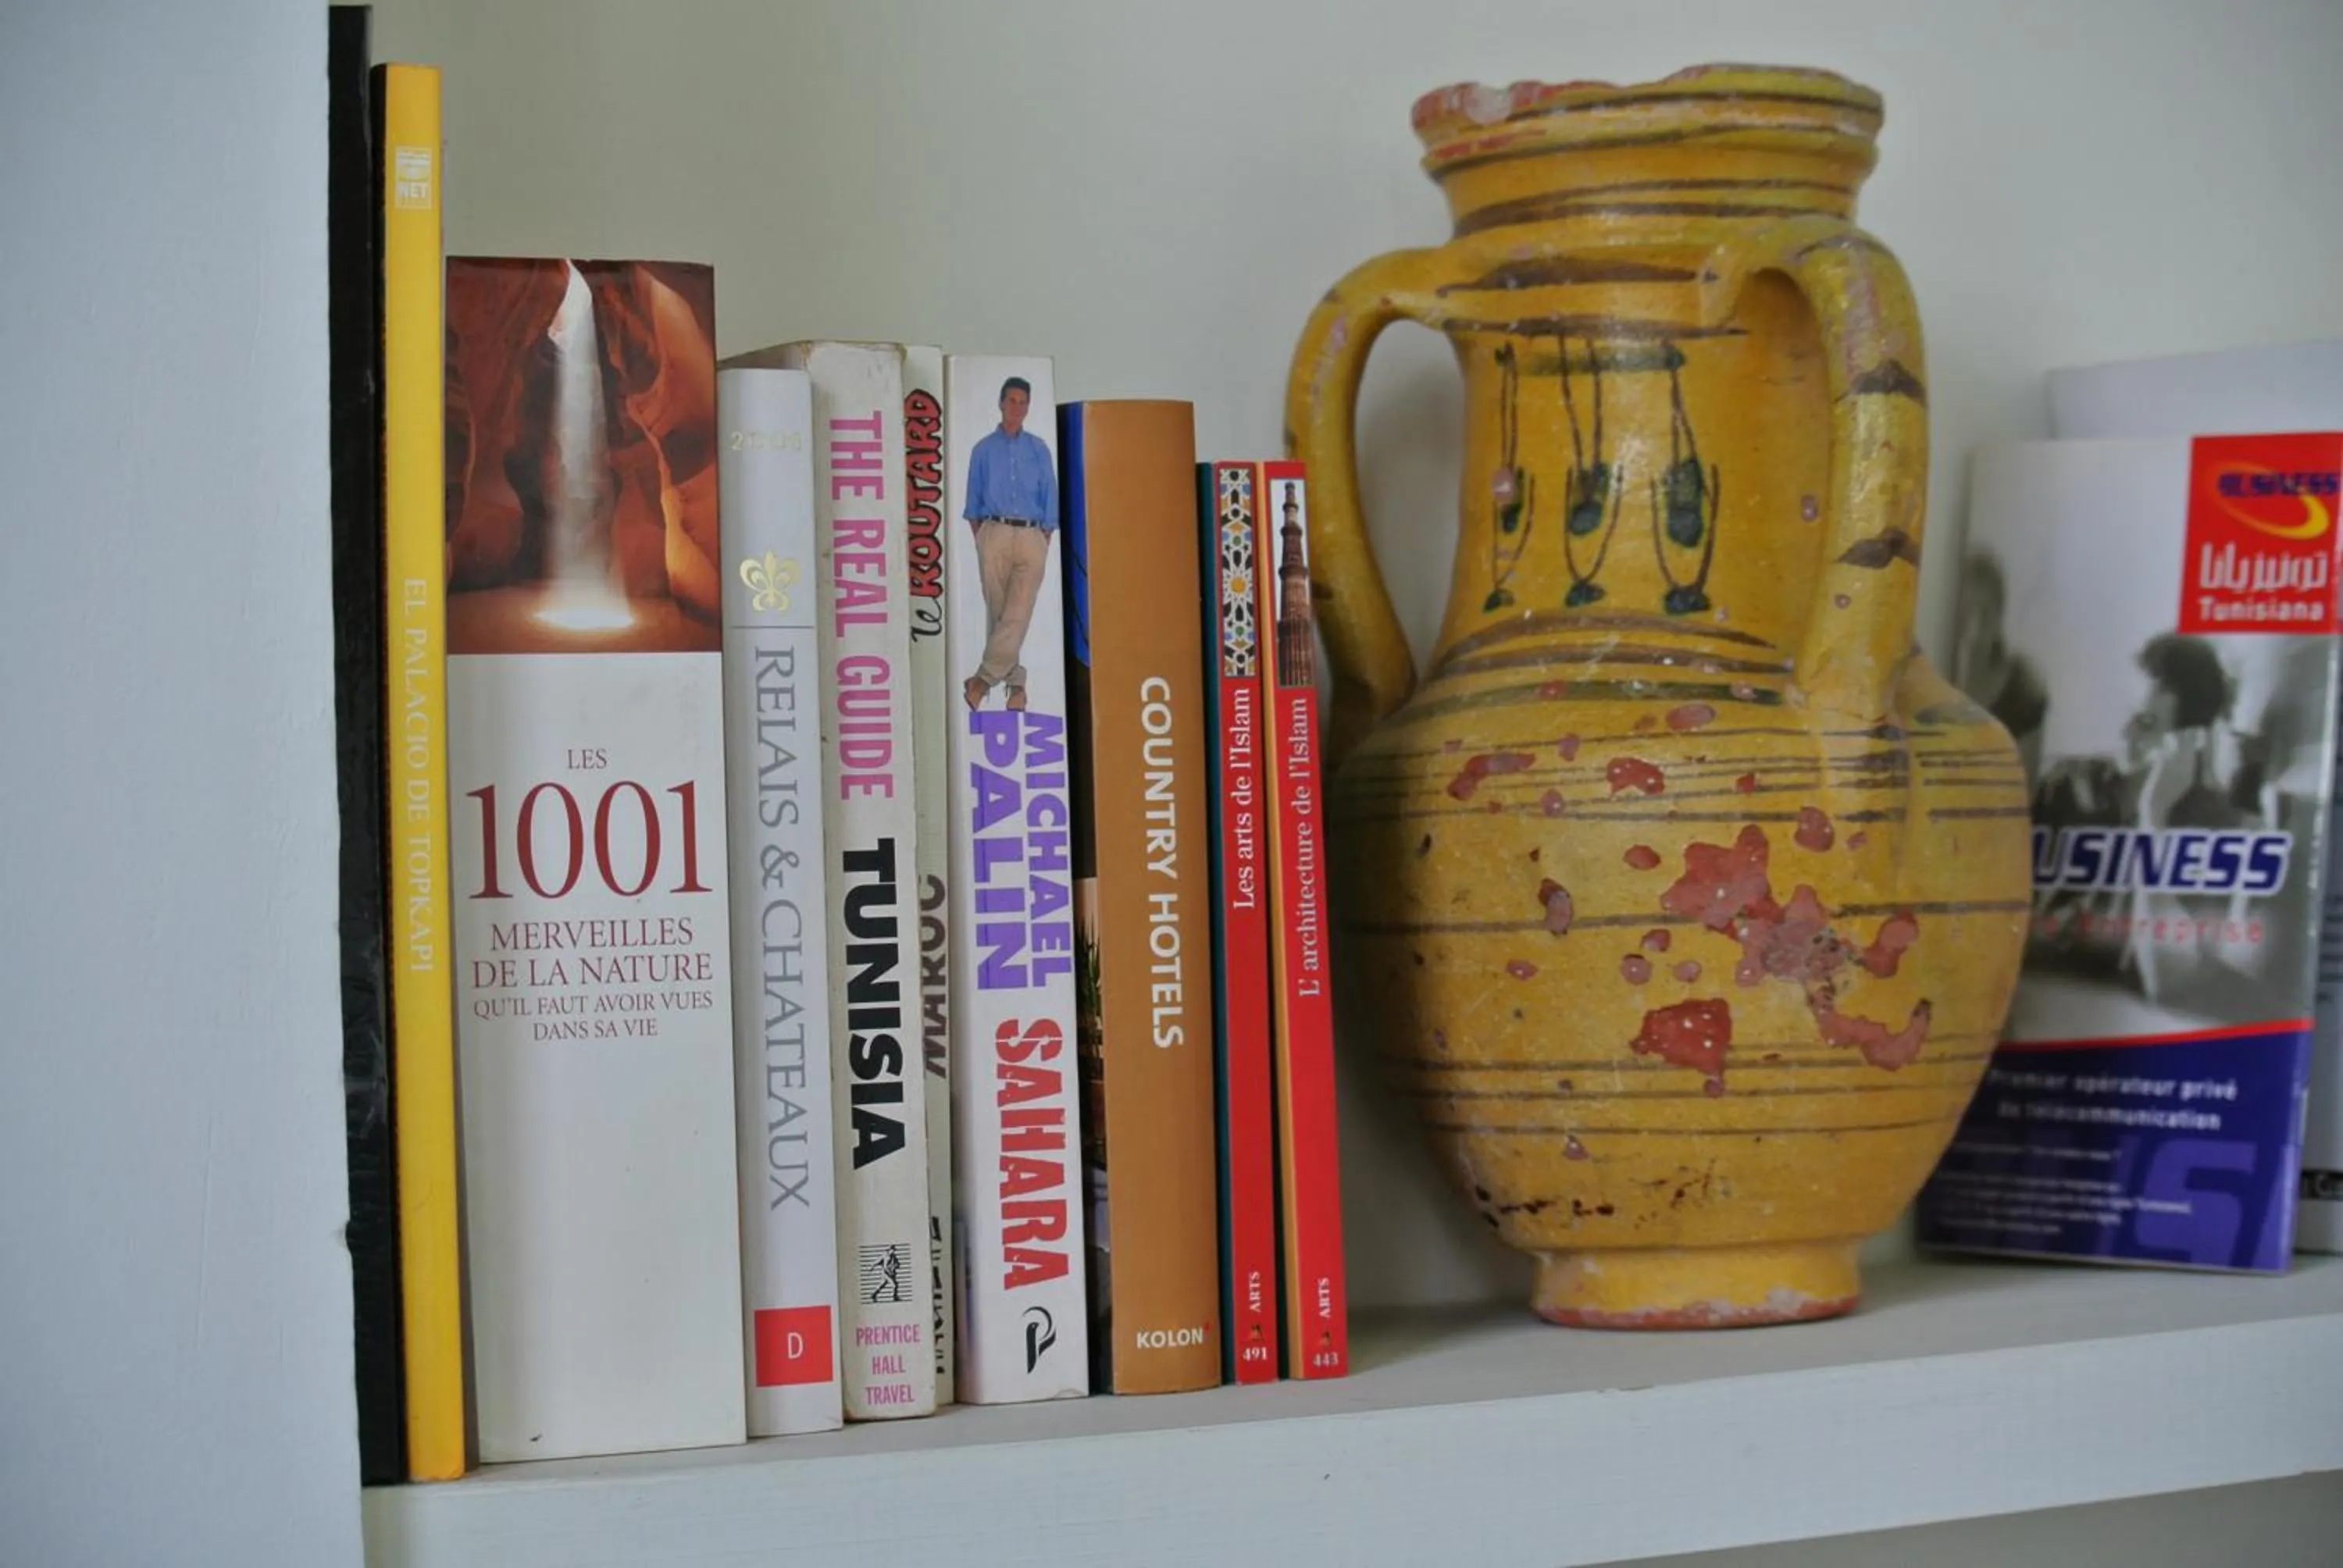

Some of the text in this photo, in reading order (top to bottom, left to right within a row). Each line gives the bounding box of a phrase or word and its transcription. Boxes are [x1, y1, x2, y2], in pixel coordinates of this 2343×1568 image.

[904, 388, 943, 598] ROUTARD
[829, 410, 894, 800] THE REAL GUIDE
[2198, 596, 2324, 622] Tunisiana
[1288, 697, 1311, 780] l'Islam
[404, 579, 433, 971] EL PALACIO DE TOPKAPI
[567, 750, 607, 770] LES
[1229, 686, 1254, 910] Les arts de l'Islam
[1290, 785, 1311, 815] de
[465, 781, 712, 899] 1001
[969, 711, 1028, 990] PALIN
[1024, 711, 1072, 987] MICHAEL
[1140, 676, 1184, 1049] COUNTRY HOTELS
[2031, 828, 2291, 893] USINESS
[491, 917, 694, 951] MERVEILLES
[755, 647, 810, 1211] RELAIS & CHATEAUX
[473, 952, 713, 989] DE LA NATURE
[473, 990, 713, 1020] QU'IL FAUT AVOIR VUES
[842, 837, 905, 1171] TUNISIA
[533, 1017, 658, 1042] DANS SA VIE
[2181, 1078, 2238, 1102] privé
[995, 1018, 1069, 1291] SAHARA
[1249, 1271, 1261, 1313] ARTS
[1318, 1278, 1332, 1318] ARTS
[787, 1332, 804, 1359] D
[856, 1324, 920, 1347] PRENTICE
[1136, 1327, 1204, 1349] KOLON
[1243, 1347, 1268, 1362] 491
[872, 1356, 906, 1375] HALL
[865, 1384, 915, 1406] TRAVEL
